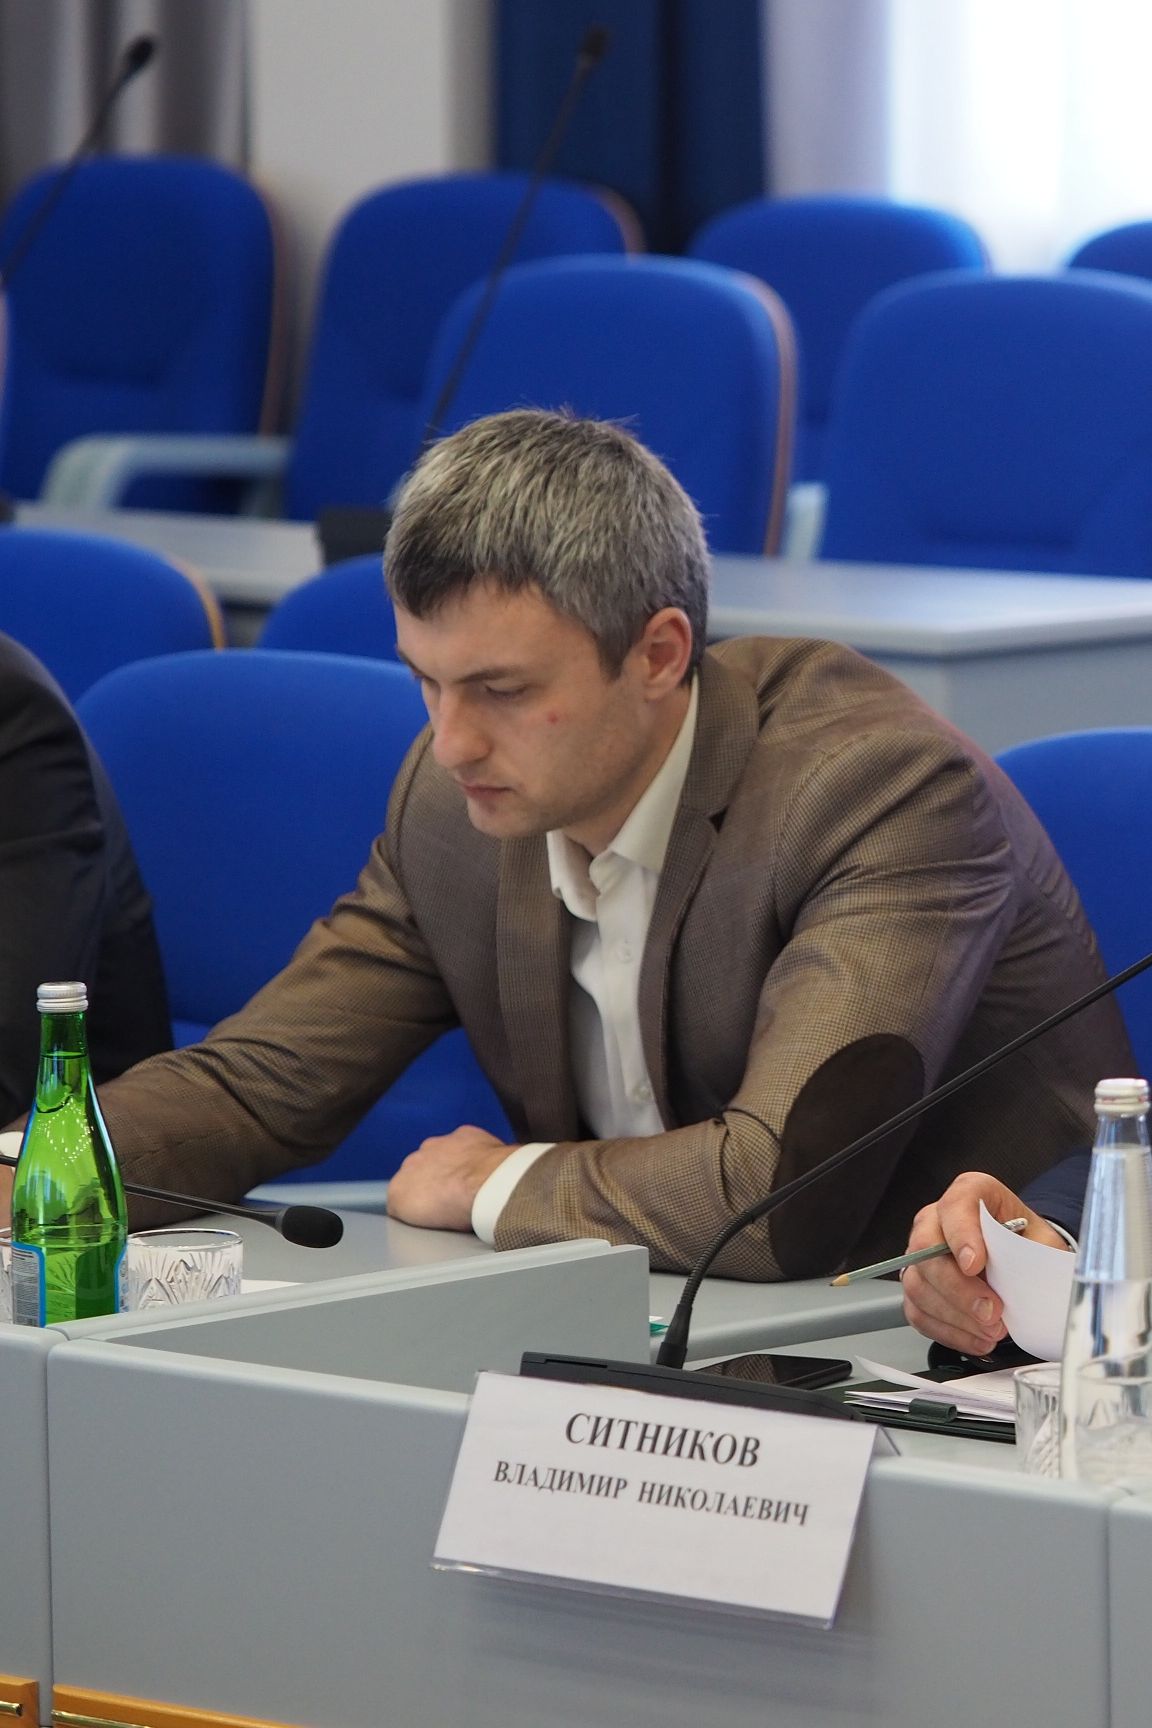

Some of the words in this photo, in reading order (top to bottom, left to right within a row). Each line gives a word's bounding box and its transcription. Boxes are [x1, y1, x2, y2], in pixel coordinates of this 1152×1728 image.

[565, 1412, 761, 1468] СИТНИКОВ
[493, 1460, 627, 1500] ВЛАДИМИР
[637, 1480, 810, 1526] НИКОЛАЕВИЧ
